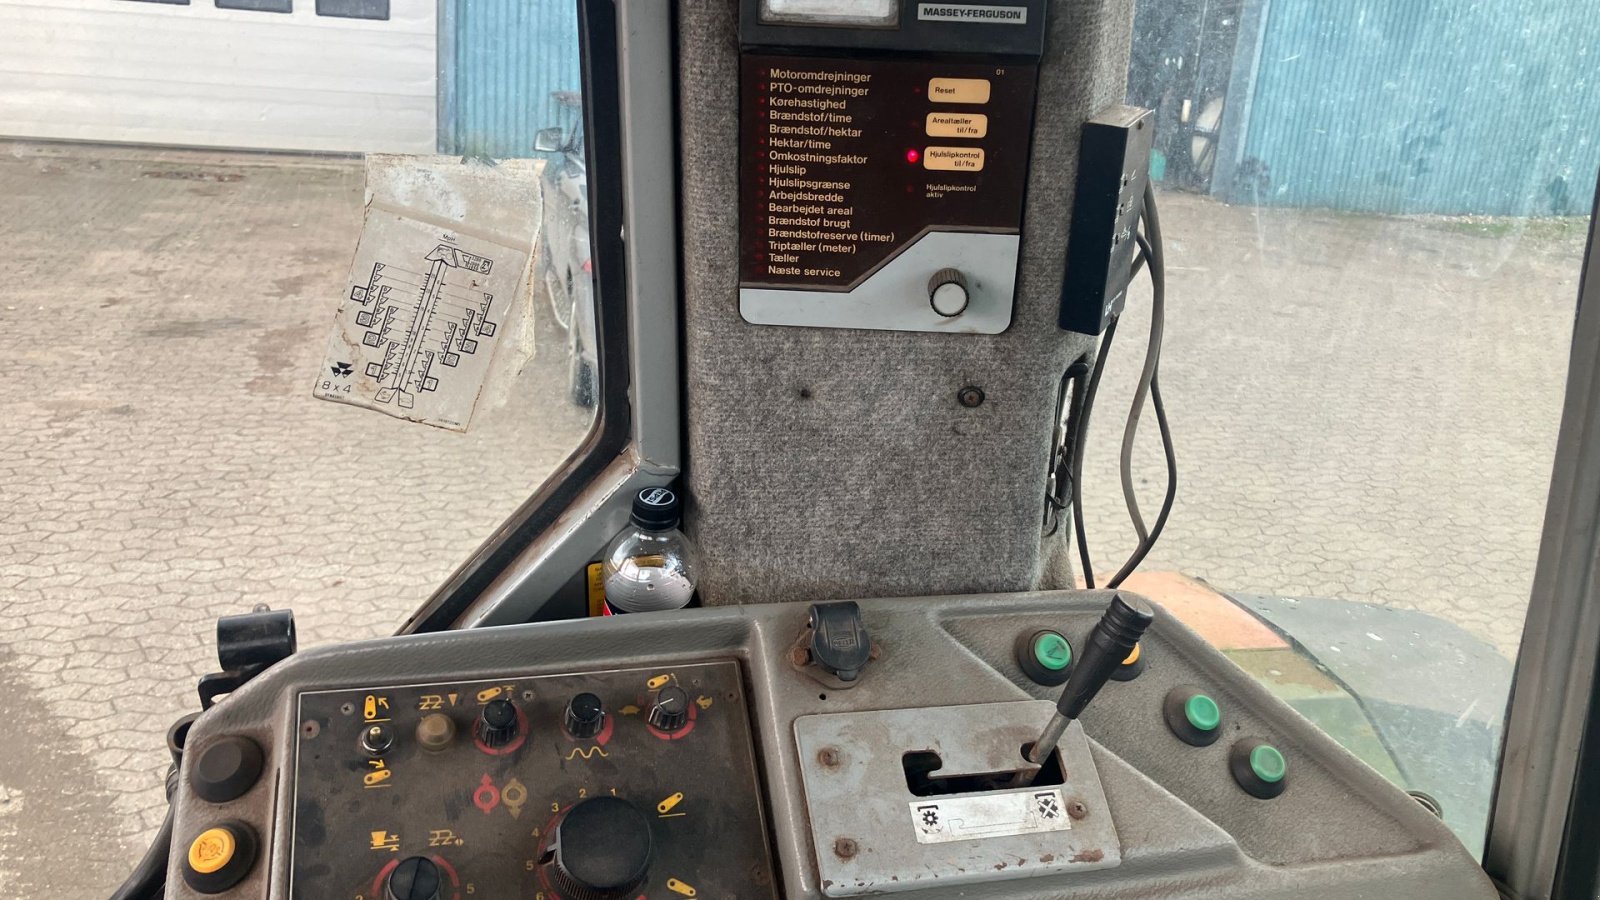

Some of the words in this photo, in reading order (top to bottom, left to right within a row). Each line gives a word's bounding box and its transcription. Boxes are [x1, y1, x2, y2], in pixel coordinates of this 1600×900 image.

[922, 6, 1022, 20] MASSEY-FERGUSON
[770, 68, 872, 83] Motoromdrejninger
[770, 82, 869, 97] PTO-omdrejninger
[934, 86, 956, 95] Reset
[769, 96, 846, 111] Kørehastighed
[769, 109, 852, 124] Brændstof/time
[932, 117, 972, 127] Arealtæller
[769, 123, 863, 138] Brændstof/hektar
[956, 126, 979, 135] til/fra
[769, 137, 831, 150] Hektar/time
[769, 150, 868, 165] Omkostningsfaktor
[929, 150, 980, 161] Hjulslipkontrol
[769, 163, 807, 177] Hjulslip
[953, 160, 976, 168] til/fra
[768, 176, 851, 191] Hjulslipsgrænse
[926, 183, 977, 193] Hjulslipkontrol
[768, 189, 844, 204] Arbejdsbredde
[926, 191, 944, 200] aktiv
[768, 202, 825, 216] Bearbejdet
[827, 205, 853, 216] areal
[768, 215, 821, 228] Brændstof
[823, 217, 851, 230] brugt
[768, 228, 858, 241] Brændstofreserve
[860, 231, 895, 243] (timer)
[768, 241, 817, 254] Triptæller
[818, 242, 856, 255] (meter)
[768, 253, 799, 264] Tæller
[768, 266, 801, 276] Næste
[804, 268, 841, 277] service
[321, 380, 331, 390] 8
[333, 385, 339, 393] x
[343, 384, 352, 394] 4
[579, 788, 587, 798] 2
[610, 788, 617, 796] 1
[551, 803, 559, 812] 3
[531, 827, 539, 837] 4
[526, 860, 534, 870] 5
[466, 883, 475, 894] 5
